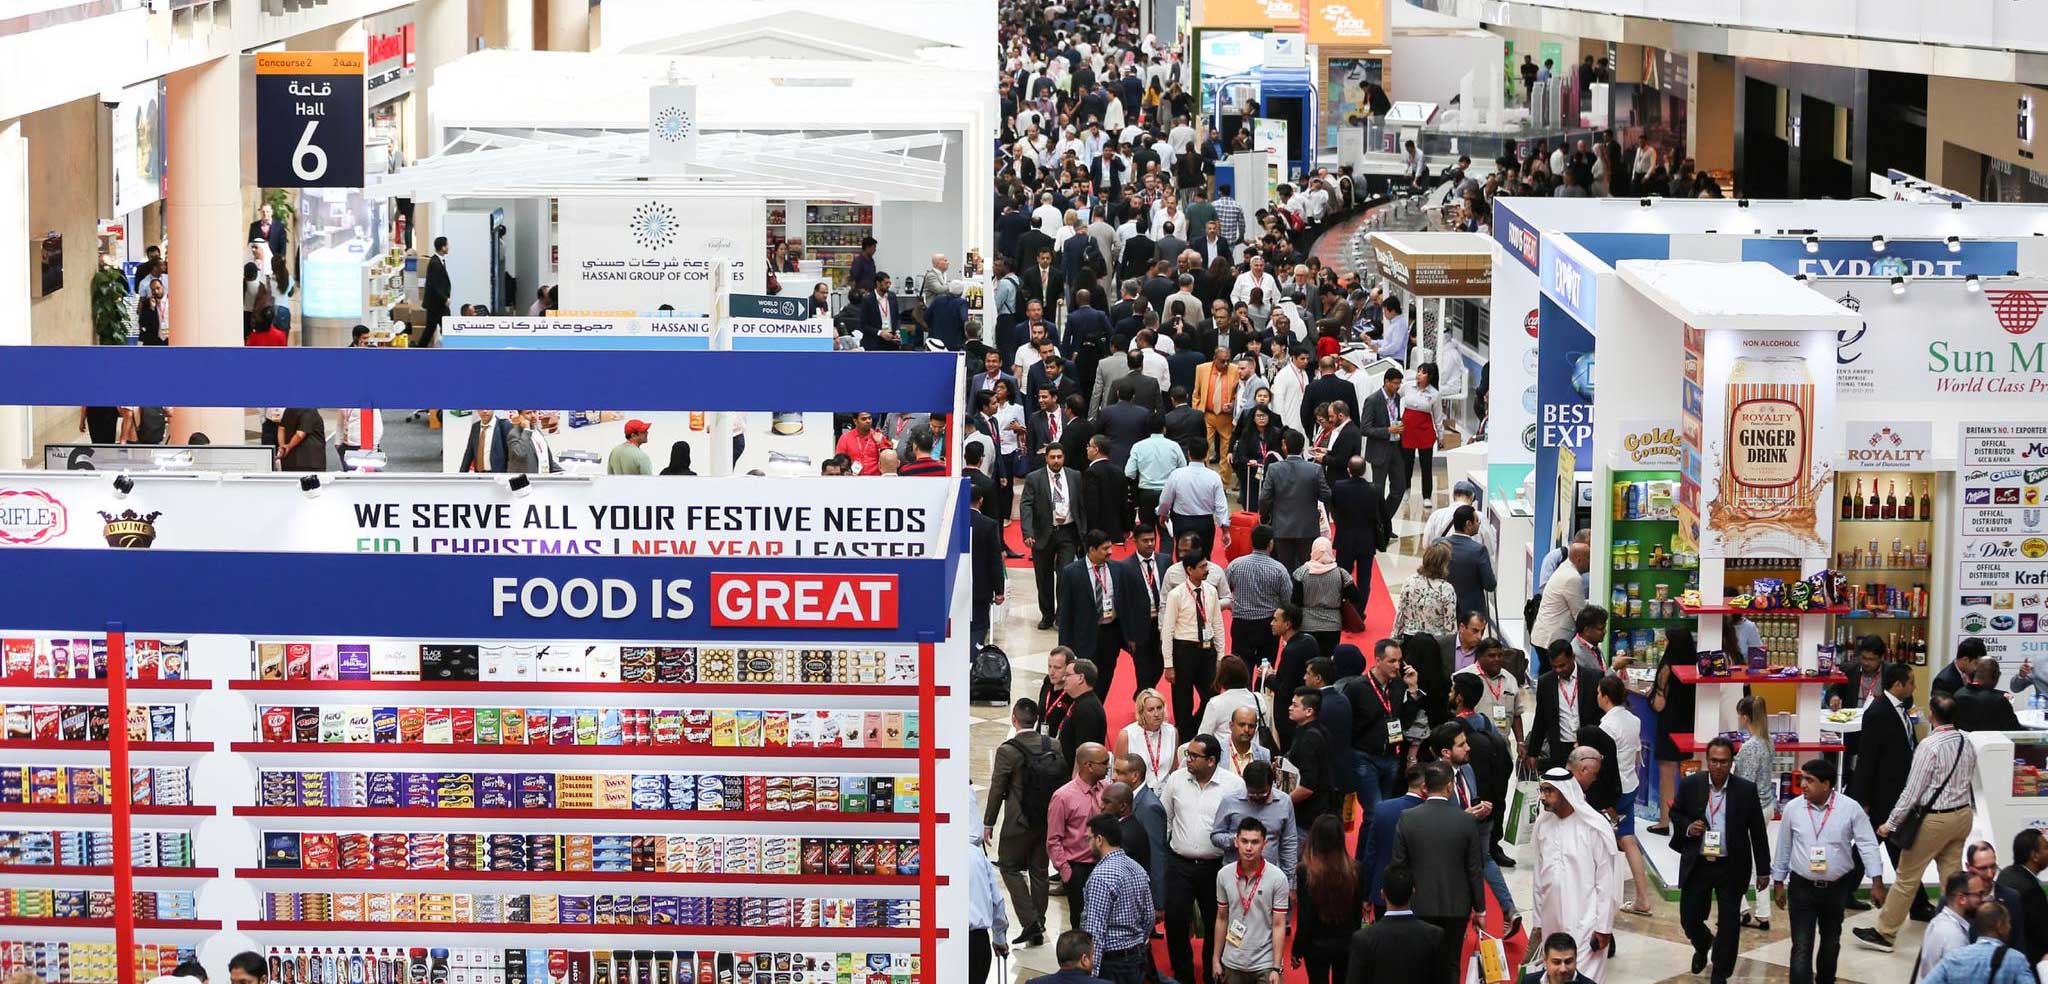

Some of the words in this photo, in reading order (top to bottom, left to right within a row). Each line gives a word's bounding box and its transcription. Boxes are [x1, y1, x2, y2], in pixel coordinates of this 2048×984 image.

[259, 59, 305, 67] Concourse
[306, 59, 312, 67] 2
[333, 59, 339, 67] 2
[288, 80, 331, 96] قاعة
[296, 102, 325, 116] Hall
[292, 120, 328, 181] 6
[582, 271, 627, 281] HASSANI
[629, 271, 666, 281] GROUP
[667, 271, 682, 281] OF
[683, 271, 744, 281] COMES
[758, 299, 779, 307] WORLD
[651, 323, 699, 333] HASSANI
[741, 323, 757, 334] OF
[758, 323, 823, 335] COMPANIES
[1742, 339, 1759, 347] NON
[1760, 339, 1801, 347] ALCOHOLIC
[1928, 340, 1995, 374] Sun
[1936, 377, 1983, 394] World
[1990, 376, 2026, 393] Class
[2028, 377, 2048, 393] Pr
[1543, 403, 1595, 424] BEST
[1742, 413, 1793, 422] ROYALTY
[1543, 425, 1594, 448] EXP
[1966, 426, 1997, 434] BRITAIN'S
[1739, 429, 1796, 447] GINGER
[1747, 448, 1788, 463] DRINK
[1847, 449, 1926, 461] ROYALTY
[1964, 470, 1989, 482] Trident
[354, 503, 401, 528] WE
[412, 503, 512, 529] SERVE
[523, 504, 578, 530] ALL
[588, 505, 675, 530] YOUR
[687, 505, 812, 531] FESTIVE
[824, 507, 926, 533] NEEDS
[108, 521, 149, 534] DIVINE
[431, 538, 602, 555] CHRISTMAS
[632, 540, 697, 555] NEW
[707, 541, 784, 556] YEAR
[1979, 541, 2018, 558] Dove
[2015, 570, 2048, 585] Kraf
[492, 577, 637, 619] FOOD
[651, 578, 695, 620] IS
[717, 579, 892, 622] GREAT
